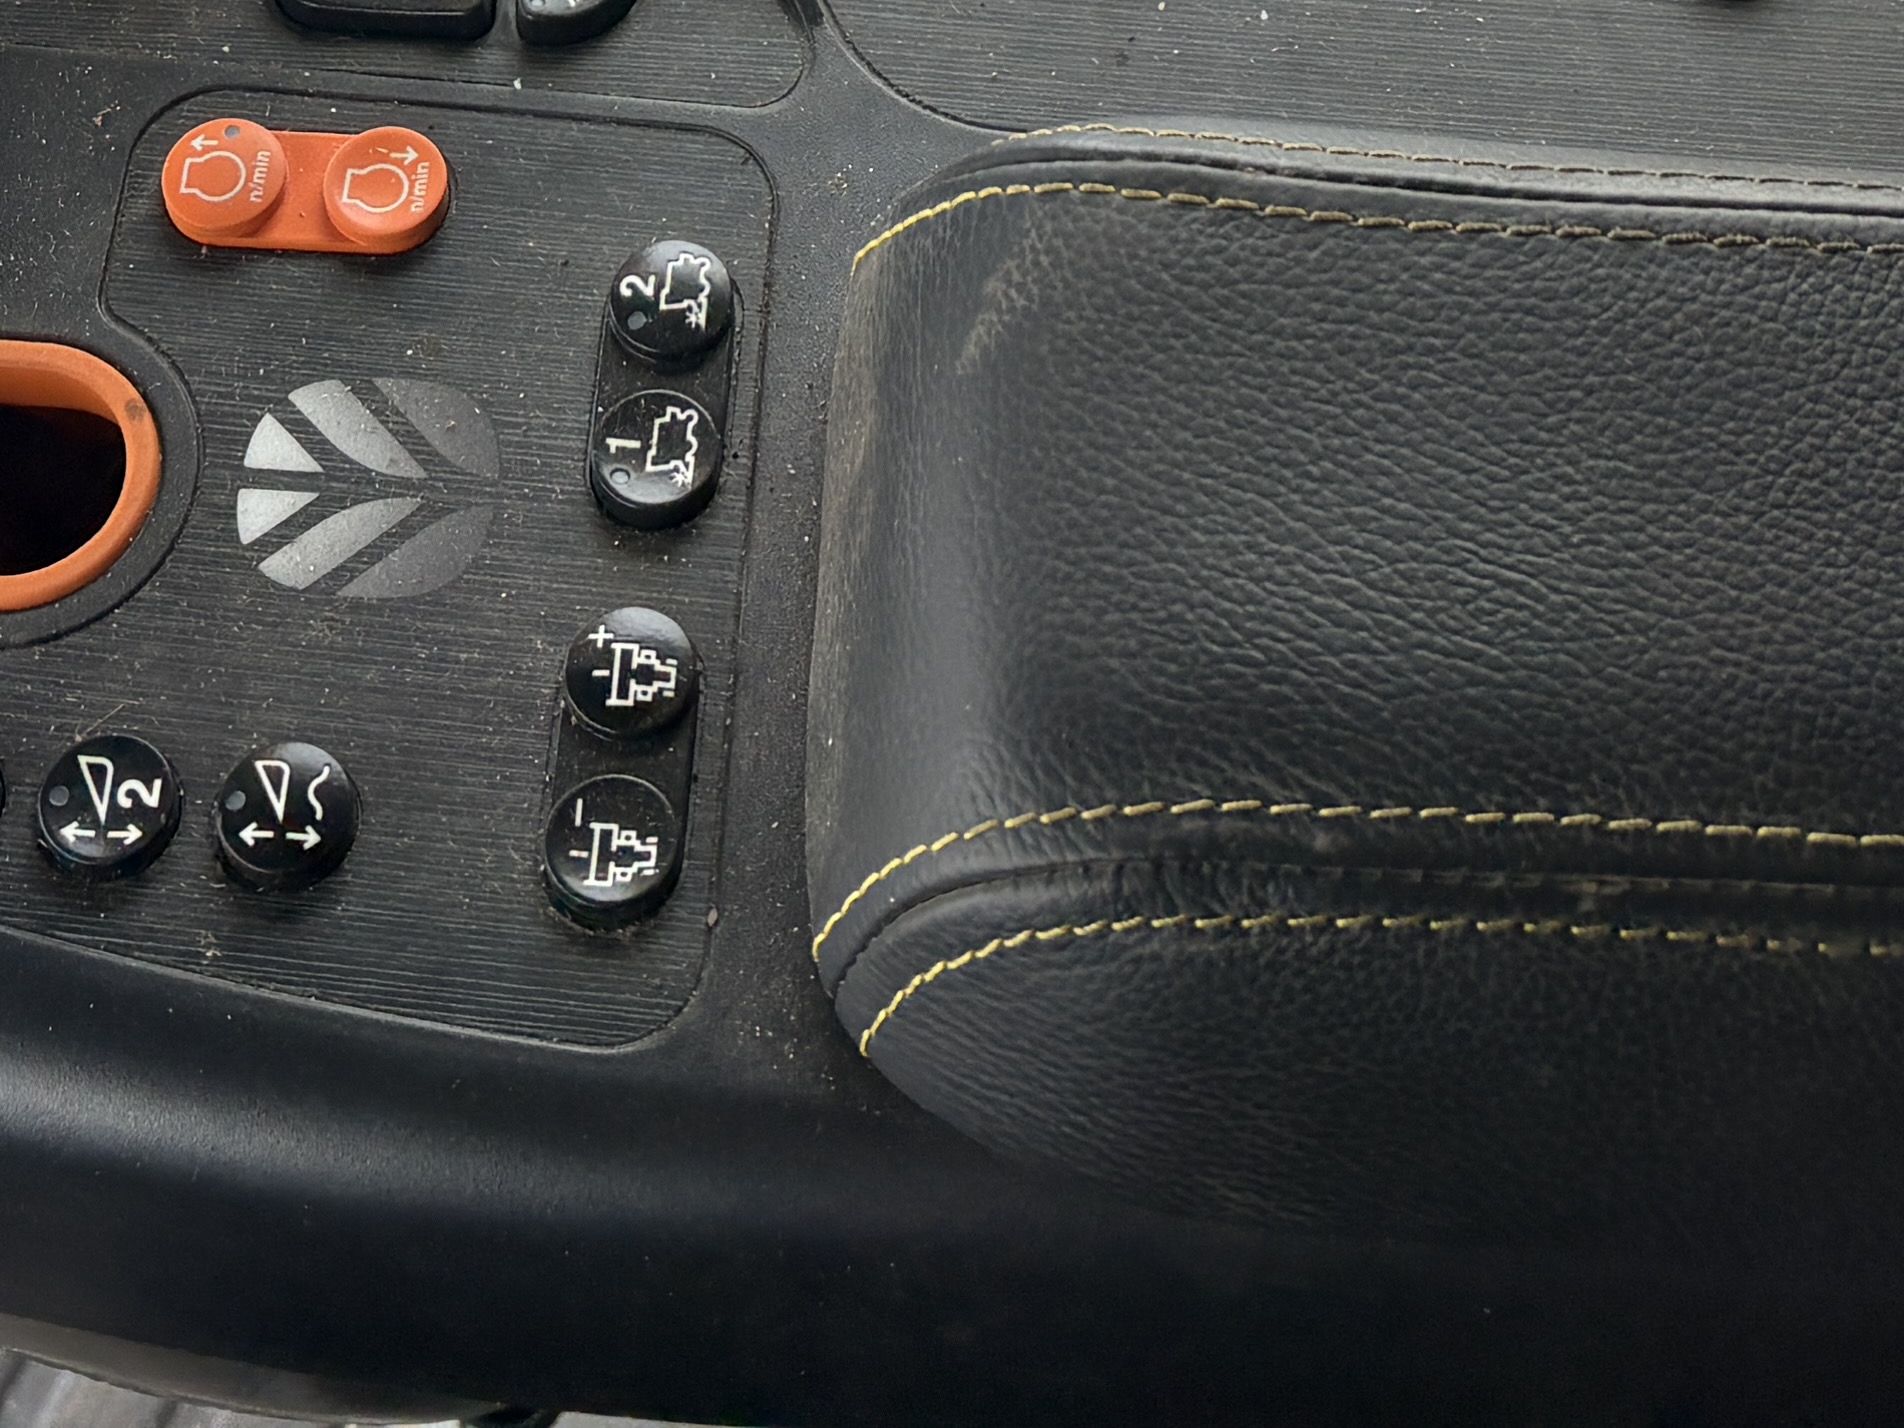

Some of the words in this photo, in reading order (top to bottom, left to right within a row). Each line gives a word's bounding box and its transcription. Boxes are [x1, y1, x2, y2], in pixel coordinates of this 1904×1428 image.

[248, 149, 273, 203] n/min
[409, 160, 431, 215] n/min
[618, 274, 656, 299] 2
[606, 438, 642, 454] 1
[116, 778, 163, 809] 2
